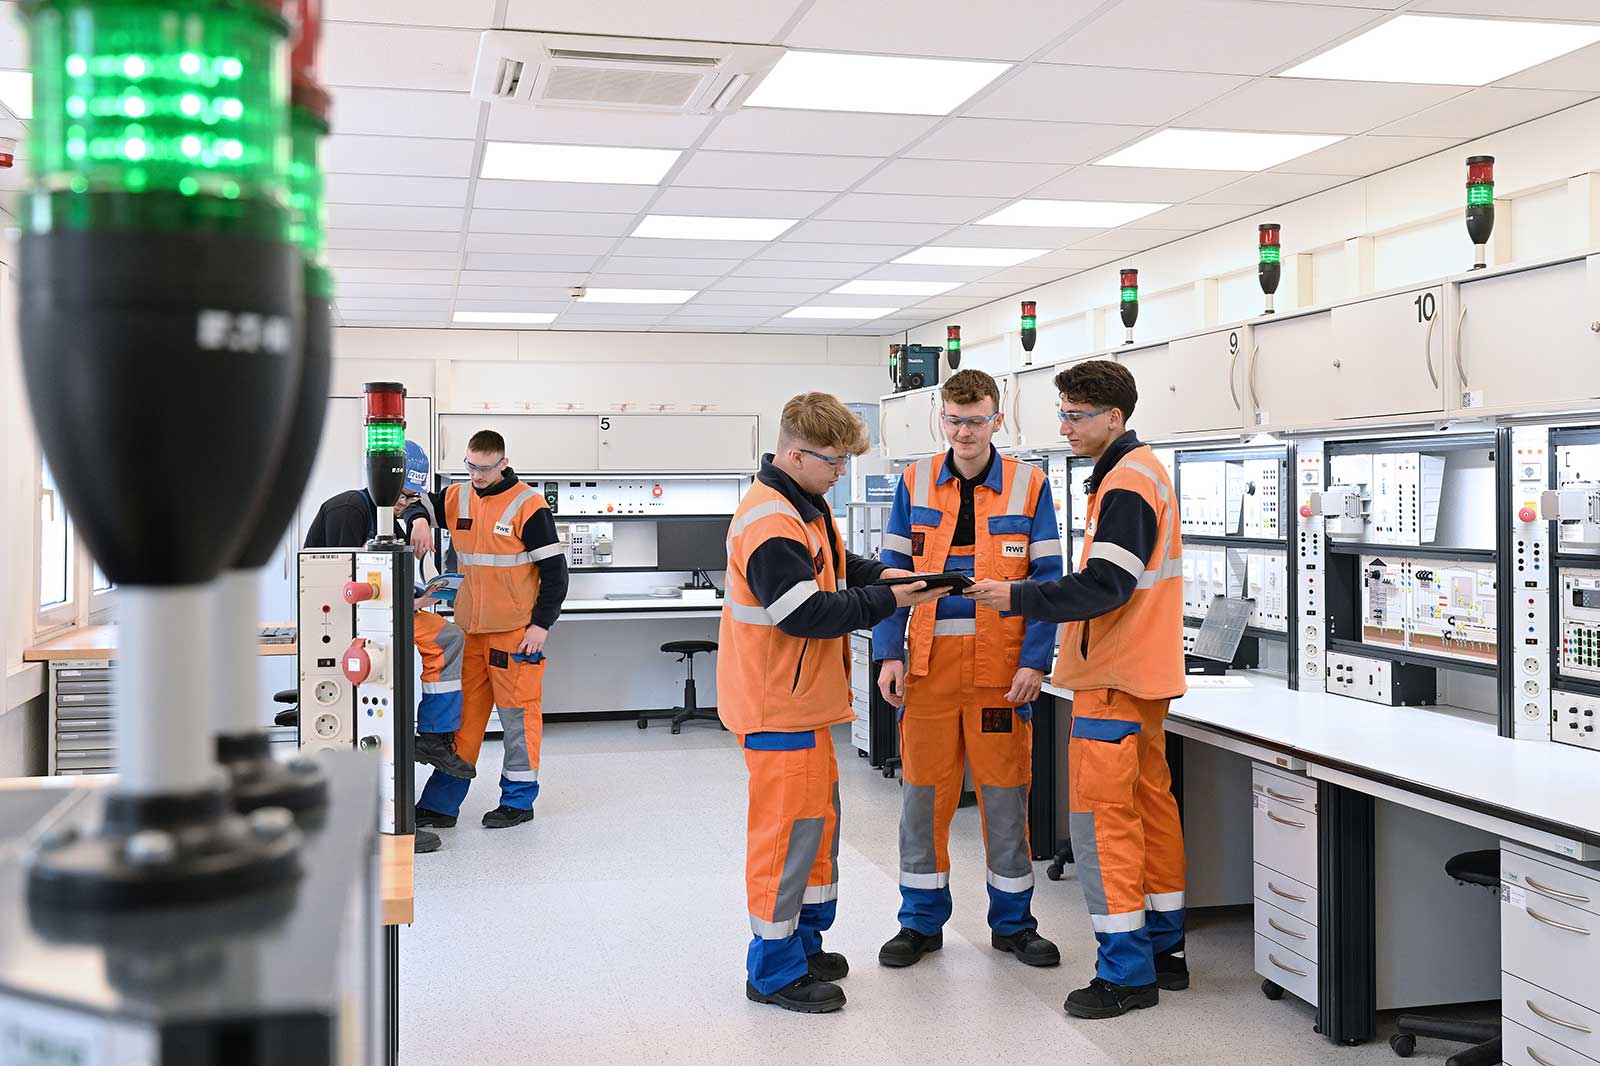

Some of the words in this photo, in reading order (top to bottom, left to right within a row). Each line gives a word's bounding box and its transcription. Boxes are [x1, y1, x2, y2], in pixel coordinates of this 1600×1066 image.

[1414, 292, 1436, 322] 10
[1230, 331, 1238, 355] 9
[600, 417, 610, 431] 5
[409, 471, 426, 480] RWE
[496, 525, 510, 534] RWE
